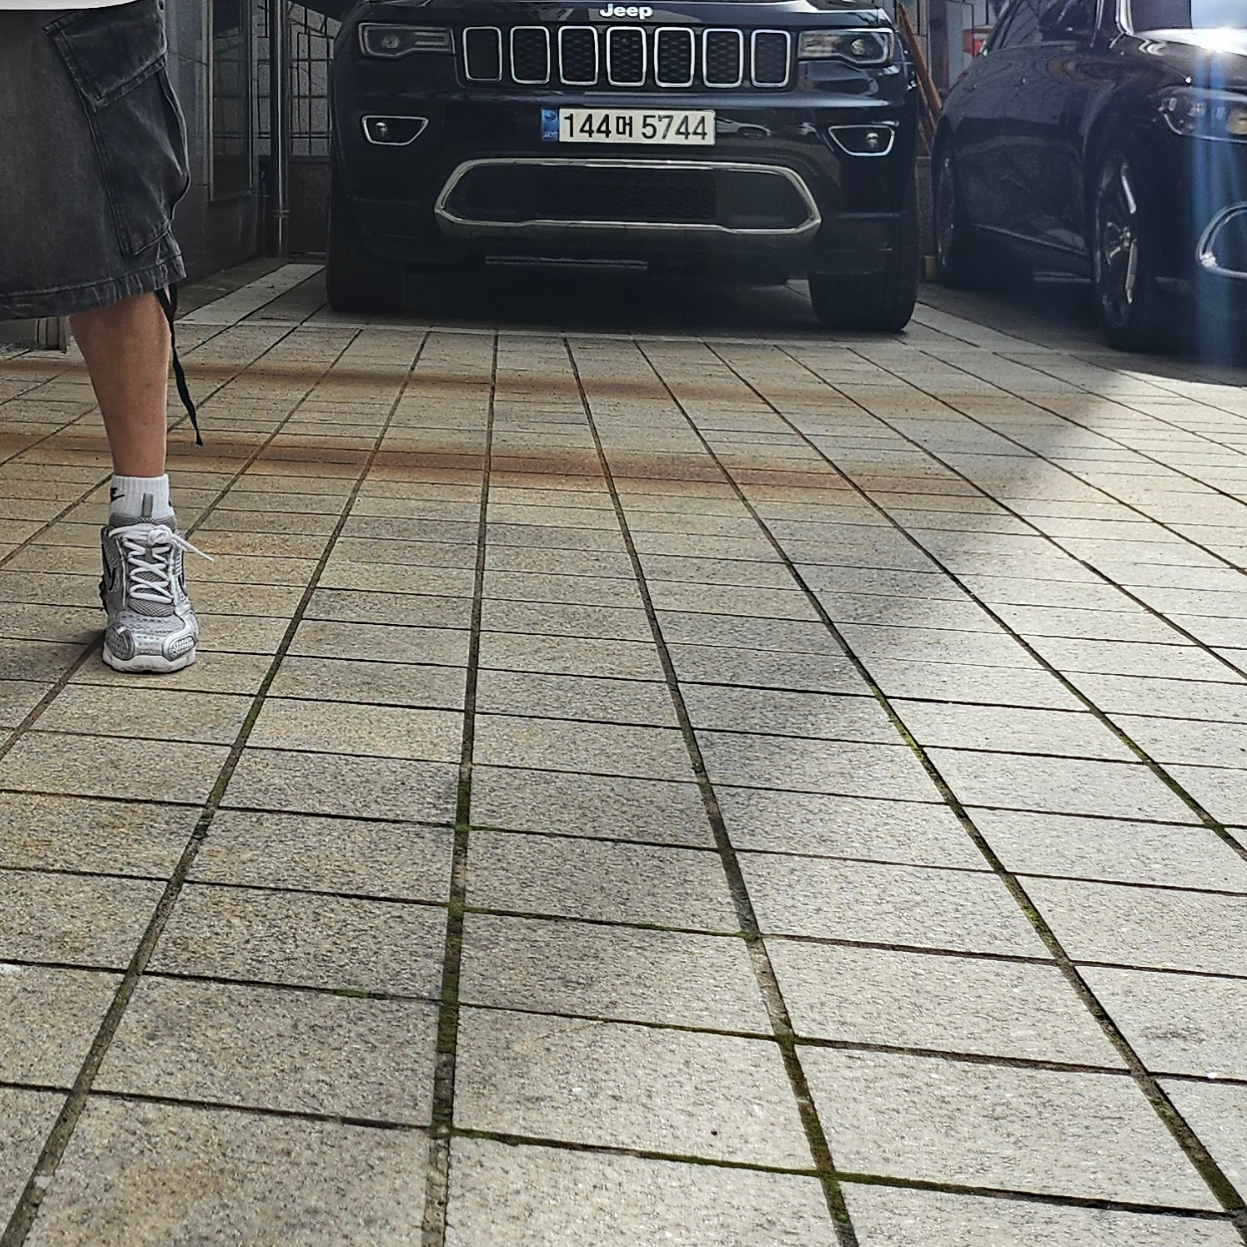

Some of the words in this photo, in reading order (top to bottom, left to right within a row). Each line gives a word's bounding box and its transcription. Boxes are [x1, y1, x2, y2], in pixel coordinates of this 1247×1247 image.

[599, 3, 653, 20] Jeep
[563, 112, 633, 139] 144머
[641, 114, 708, 141] 5744
